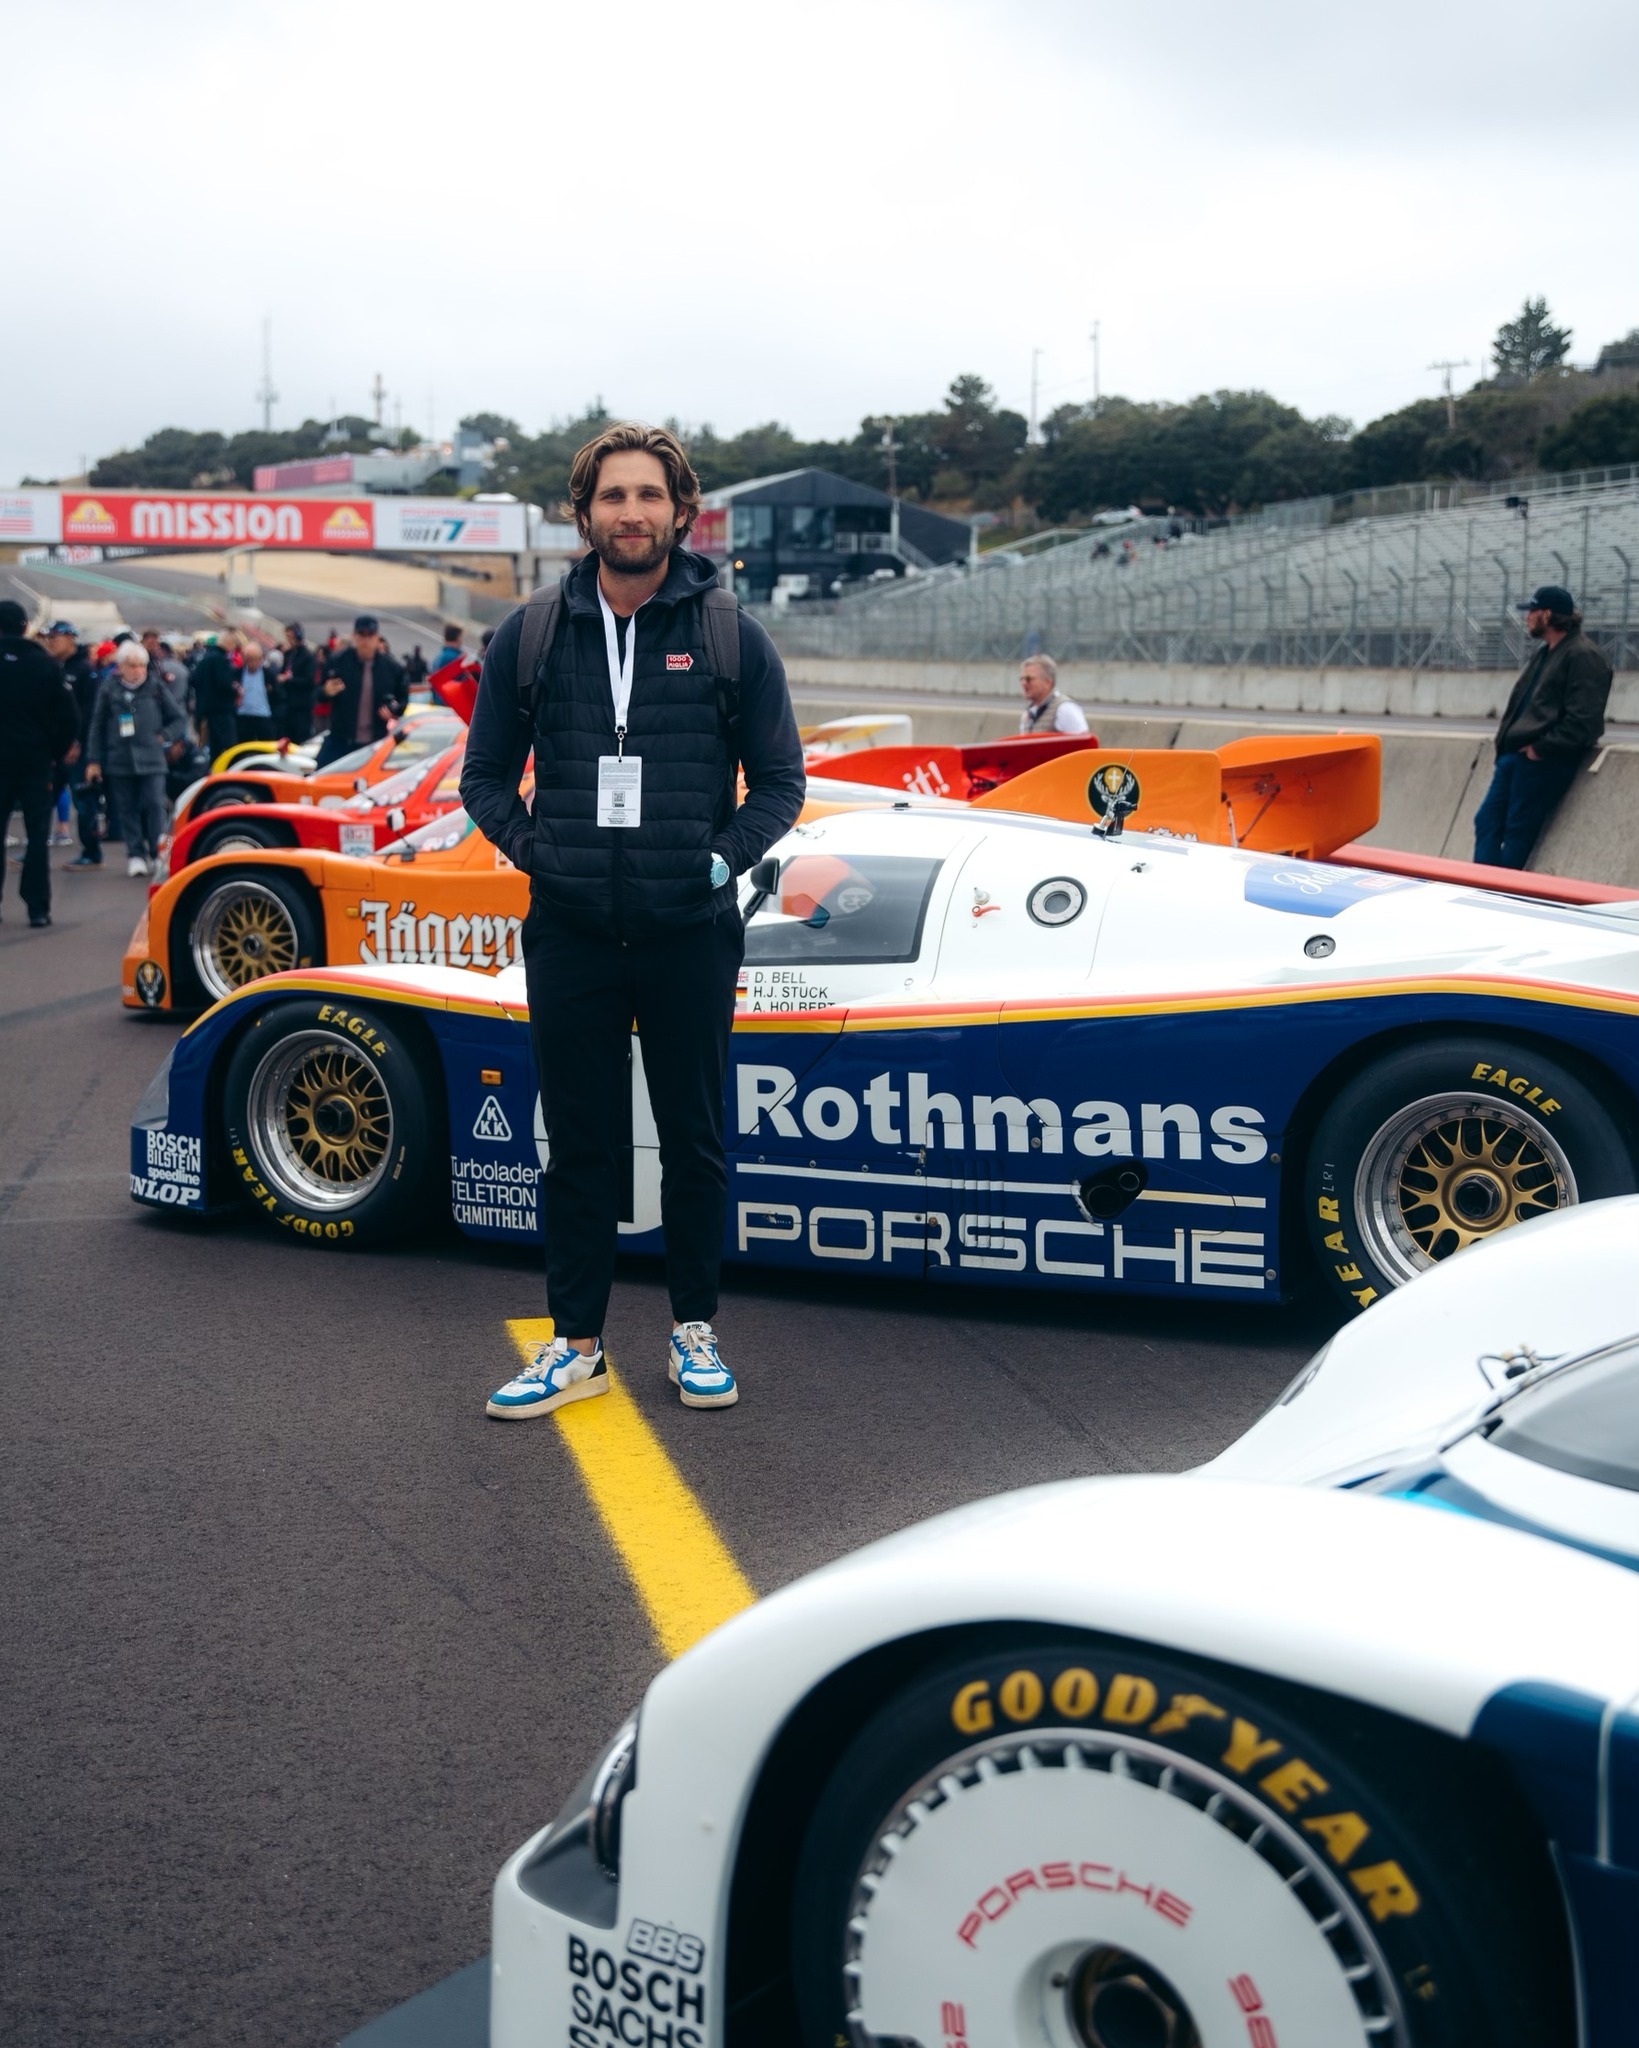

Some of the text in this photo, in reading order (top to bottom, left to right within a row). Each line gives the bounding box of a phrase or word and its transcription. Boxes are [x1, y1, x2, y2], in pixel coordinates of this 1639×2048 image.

[442, 518, 467, 542] 7
[753, 985, 828, 999] H.J. STUCK
[754, 971, 807, 984] D. BELL
[318, 1003, 387, 1058] EAGLE
[736, 1063, 1269, 1166] Rothmans
[1470, 1061, 1562, 1116] EAGLE
[147, 1129, 201, 1156] BOSCH
[147, 1148, 201, 1173] BILSTEIN
[450, 1154, 542, 1185] Turbolader
[147, 1165, 201, 1186] speedline
[232, 1146, 355, 1239] GOODYEAR
[451, 1179, 537, 1208] TELETRON
[736, 1200, 1266, 1290] PORSCHE
[951, 1666, 1421, 1922] GOODYEAR
[957, 1861, 1194, 1950] PORSCHE
[625, 1917, 706, 1975] BBS
[568, 1932, 706, 2025] BOSCH
